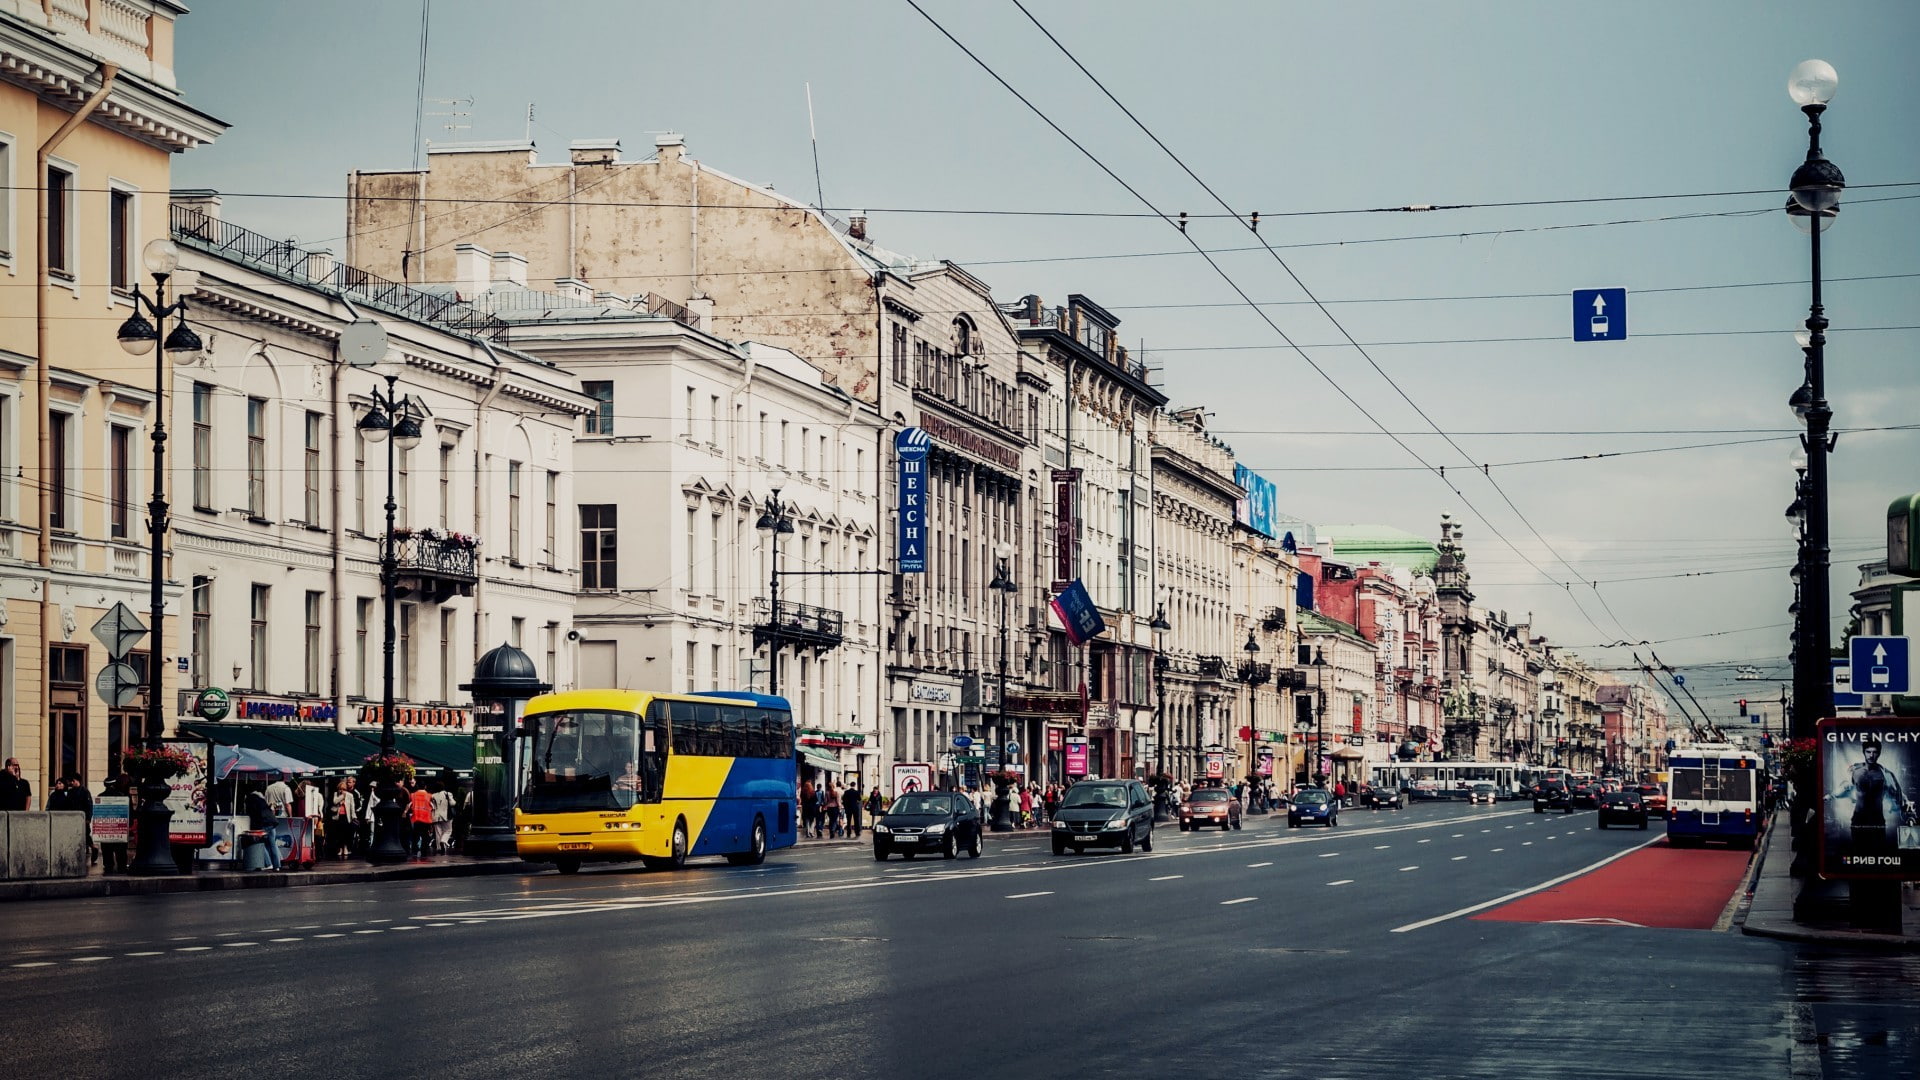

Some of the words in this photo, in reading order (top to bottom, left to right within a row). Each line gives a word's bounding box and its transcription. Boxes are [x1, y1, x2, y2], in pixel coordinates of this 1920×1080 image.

[904, 461, 920, 556] ШЕКСНА
[1826, 732, 1920, 742] GIVENCHY
[1209, 762, 1220, 771] 19
[1740, 760, 1746, 768] 5
[1853, 856, 1876, 865] РИВ
[1878, 856, 1901, 865] ГОШ
